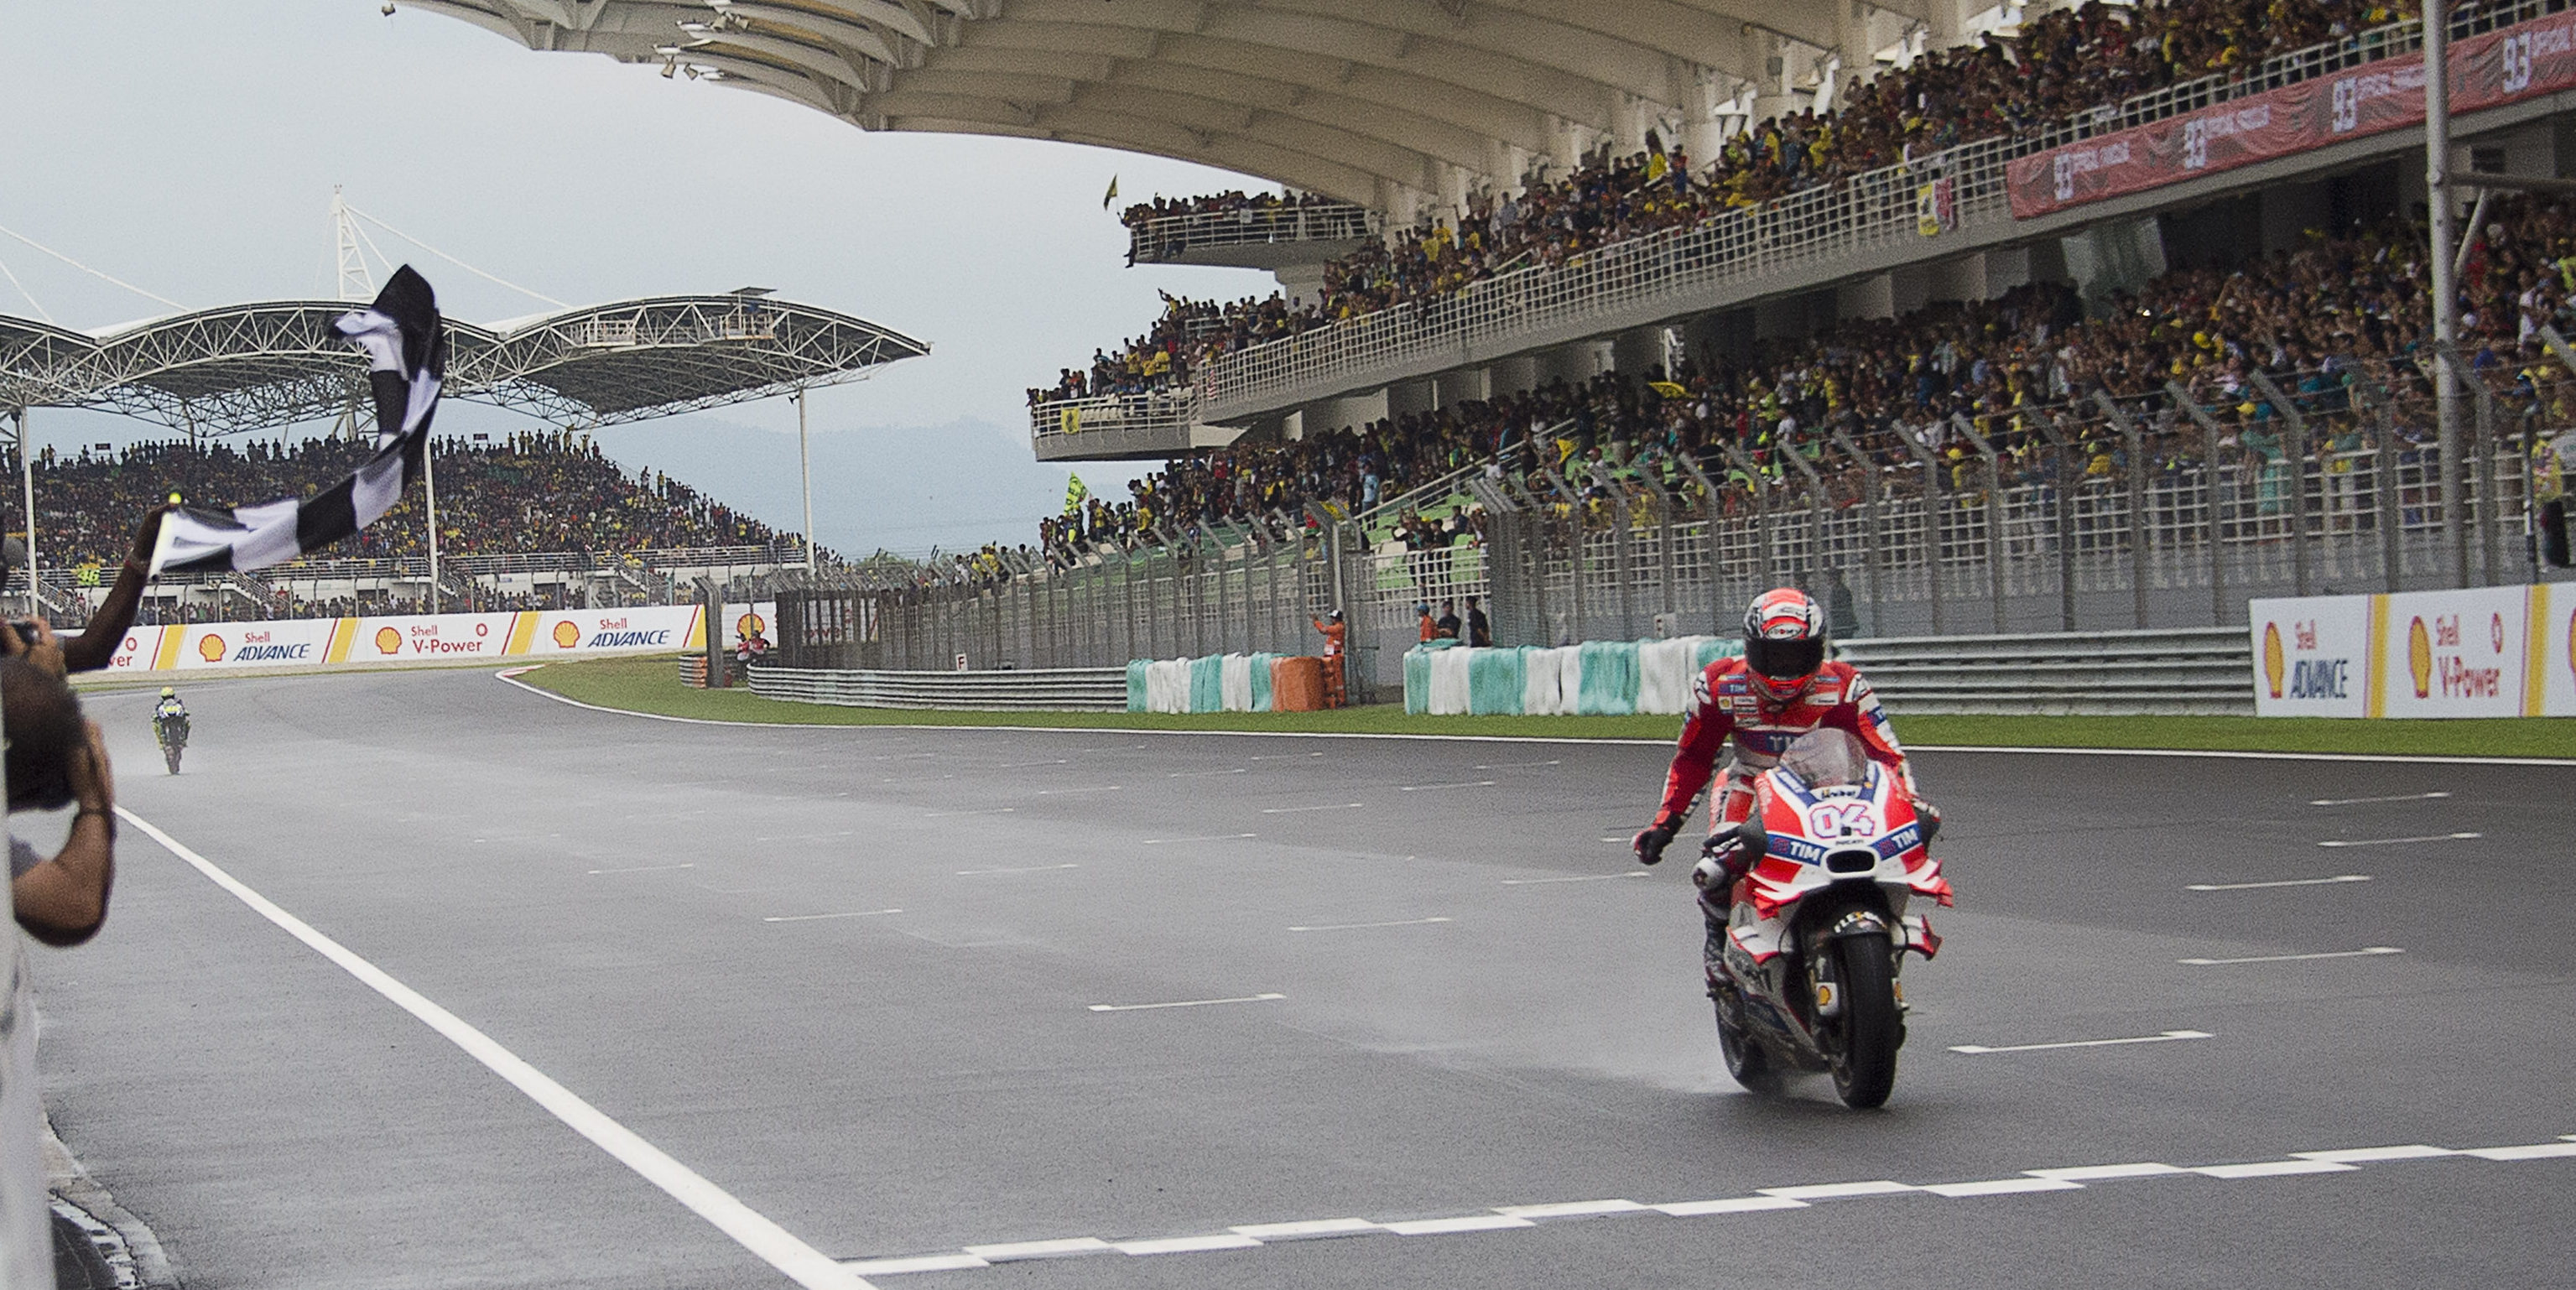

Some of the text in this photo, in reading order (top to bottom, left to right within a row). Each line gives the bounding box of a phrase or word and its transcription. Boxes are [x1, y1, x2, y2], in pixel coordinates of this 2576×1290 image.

[2503, 32, 2531, 92] 93
[2334, 77, 2356, 133] 93
[2184, 119, 2205, 169] 93
[2054, 153, 2073, 200] 93
[78, 568, 100, 582] 46
[411, 625, 438, 637] Shell
[600, 618, 627, 629] Shell
[2436, 614, 2459, 648] Shell
[245, 632, 270, 643] Shell
[588, 630, 671, 648] ADVANCE
[2295, 620, 2316, 650] Shell
[233, 643, 310, 661] ADVANCE
[413, 639, 482, 653] V-Power
[958, 656, 965, 669] F
[2289, 659, 2348, 699] ADVANCE
[2438, 656, 2501, 698] V-Power
[1809, 803, 1875, 839] 04
[1891, 828, 1918, 848] TIM
[1790, 841, 1820, 861] TIM
